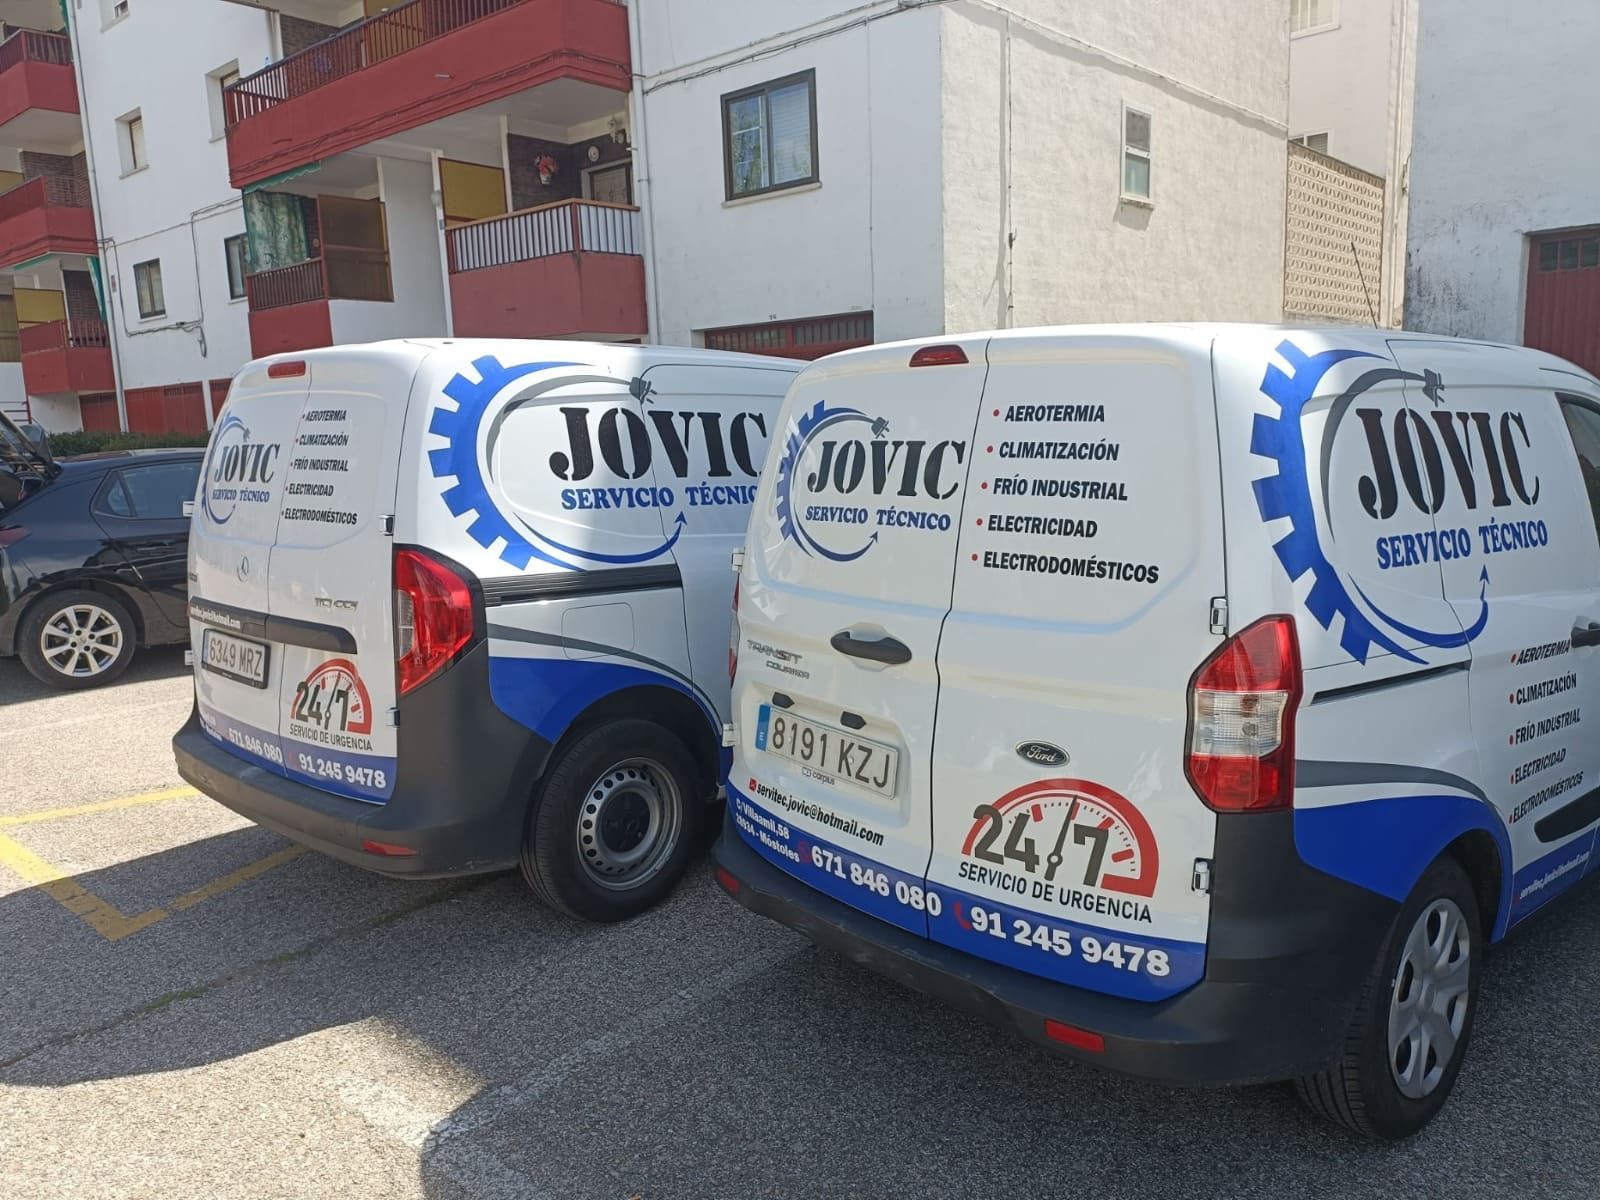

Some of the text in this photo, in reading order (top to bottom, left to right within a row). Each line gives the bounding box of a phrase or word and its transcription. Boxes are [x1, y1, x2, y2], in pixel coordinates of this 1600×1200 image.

[306, 409, 347, 421] AEROTERMIA
[1004, 405, 1106, 422] AEROTERMIA
[299, 430, 349, 446] CLIMATIZACIÓN
[549, 407, 767, 481] JOVIC
[999, 438, 1120, 461] CLIMATIZACIÓN
[214, 443, 281, 483] JOVIC
[293, 456, 349, 472] FRÍO INDUSTRIAL
[807, 439, 966, 500] JOVIC
[1356, 407, 1540, 520] JOVIC
[211, 486, 271, 503] SERVICIO TÉCNICO
[288, 482, 334, 497] ELECTRICIDAD
[560, 480, 758, 511] SERVICIO TÉCNIC
[993, 473, 1128, 501] FRÍO INDUSTRIAL
[284, 507, 358, 525] ELECTRODOMÉSTICOS
[806, 505, 951, 531] SERVICIO TÉCNICO
[987, 514, 1098, 538] ELECTRICIDAD
[1376, 516, 1548, 570] SERVICIO TÉCNICO
[983, 551, 1159, 584] ELECTRODOMÉSTICOS
[209, 637, 263, 677] 6349 MRZ
[747, 639, 803, 665] TRANSIT
[1516, 639, 1571, 666] AEROTERMIA
[1516, 670, 1577, 705] CLIMATIZACIÓN
[289, 723, 373, 751] SERVICIO DE URGENCIA
[1515, 708, 1581, 746] FRÍO INDUSTRIAL
[772, 717, 890, 788] 8191 KZJ
[1026, 744, 1057, 762] Ford
[1515, 748, 1567, 784] ELECTRICIDAD
[299, 753, 387, 789] 91 245 9478
[1513, 770, 1584, 824] ELECTRODOMÉSTICOS
[756, 782, 885, 847] servitec.jovic@hotmail.com
[811, 845, 942, 917] 671 846 080
[958, 861, 1152, 923] SERVICIO DE URGENCIA
[970, 906, 1171, 977] 91 245 9478
